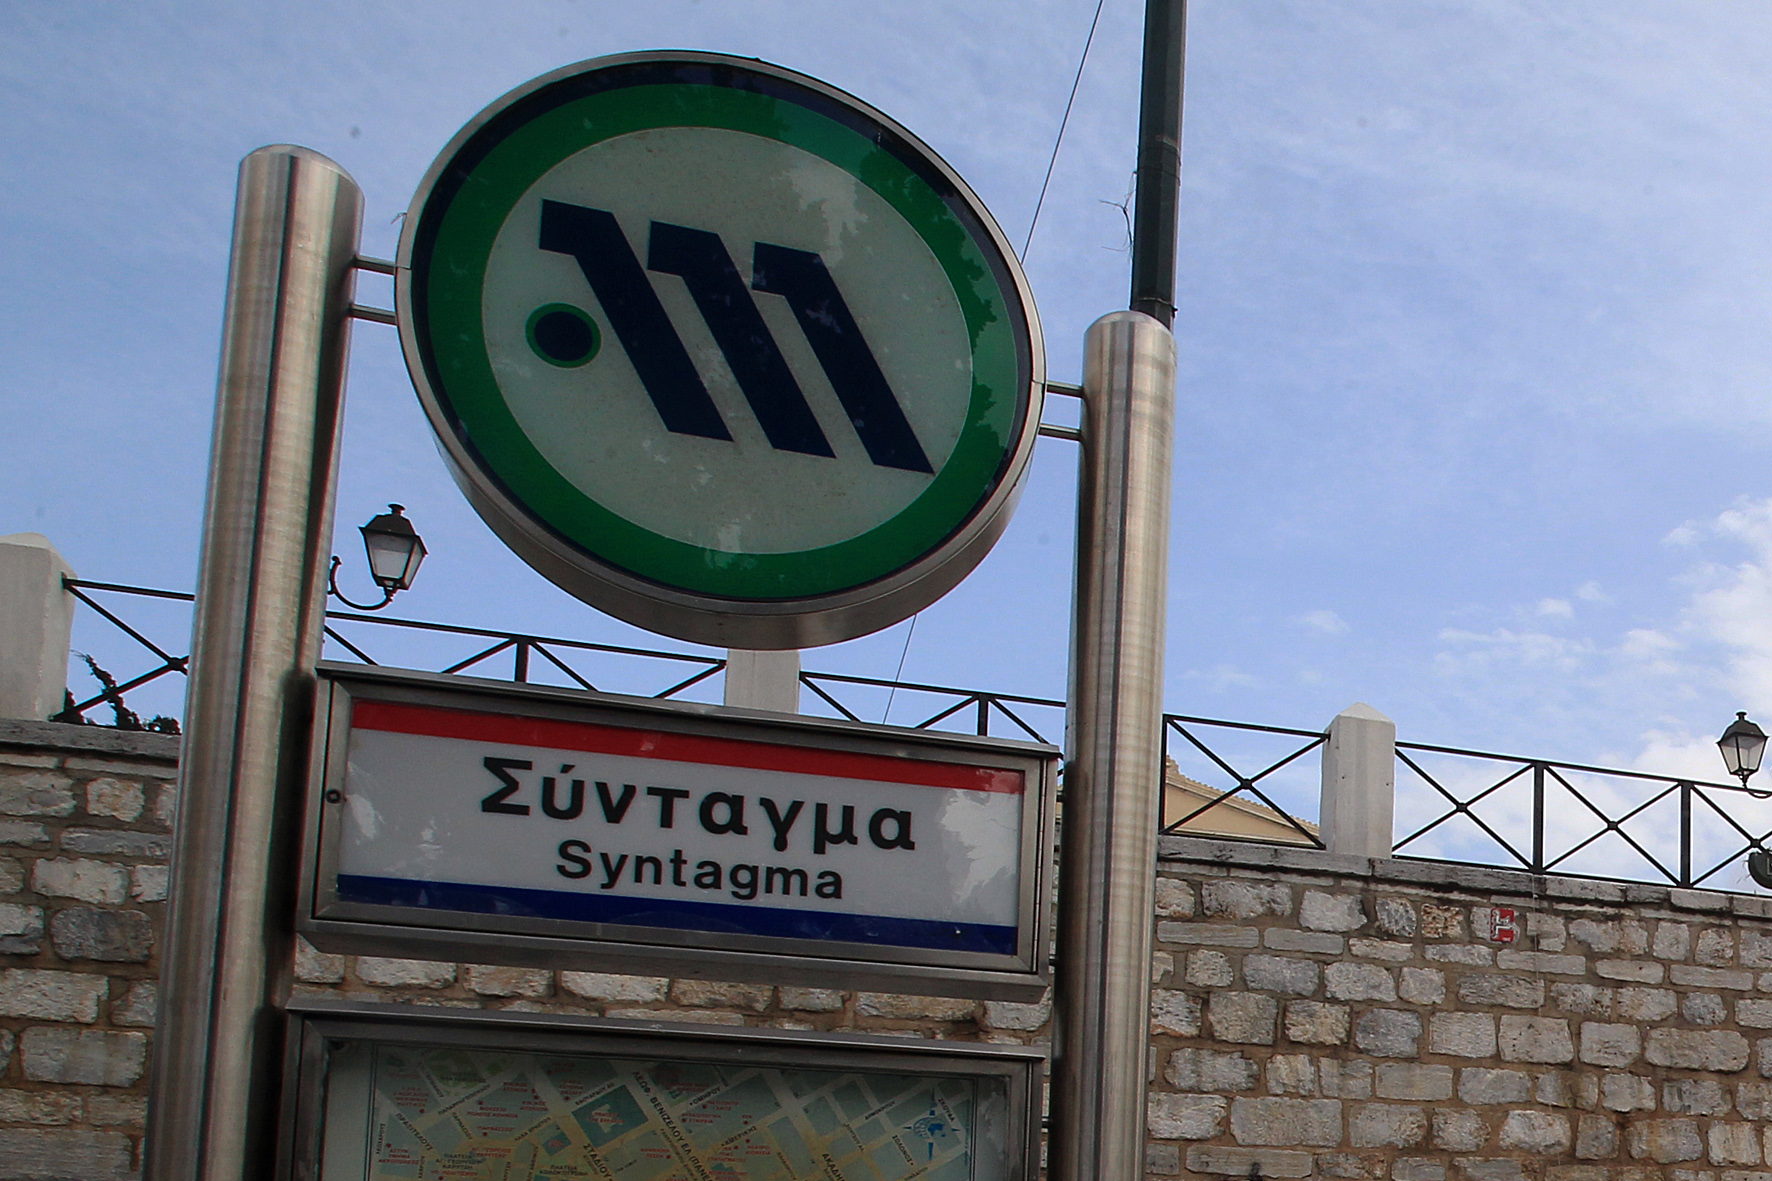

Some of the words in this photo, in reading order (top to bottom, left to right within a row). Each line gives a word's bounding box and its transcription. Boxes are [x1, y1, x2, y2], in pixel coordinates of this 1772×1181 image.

[481, 756, 916, 852] Σύνταγμα
[556, 840, 844, 900] Syntagma
[650, 1097, 685, 1142] ΒΕΝΙΖΕΛΟΥ
[583, 1143, 610, 1179] ΣΤΑΔΙΟΥ
